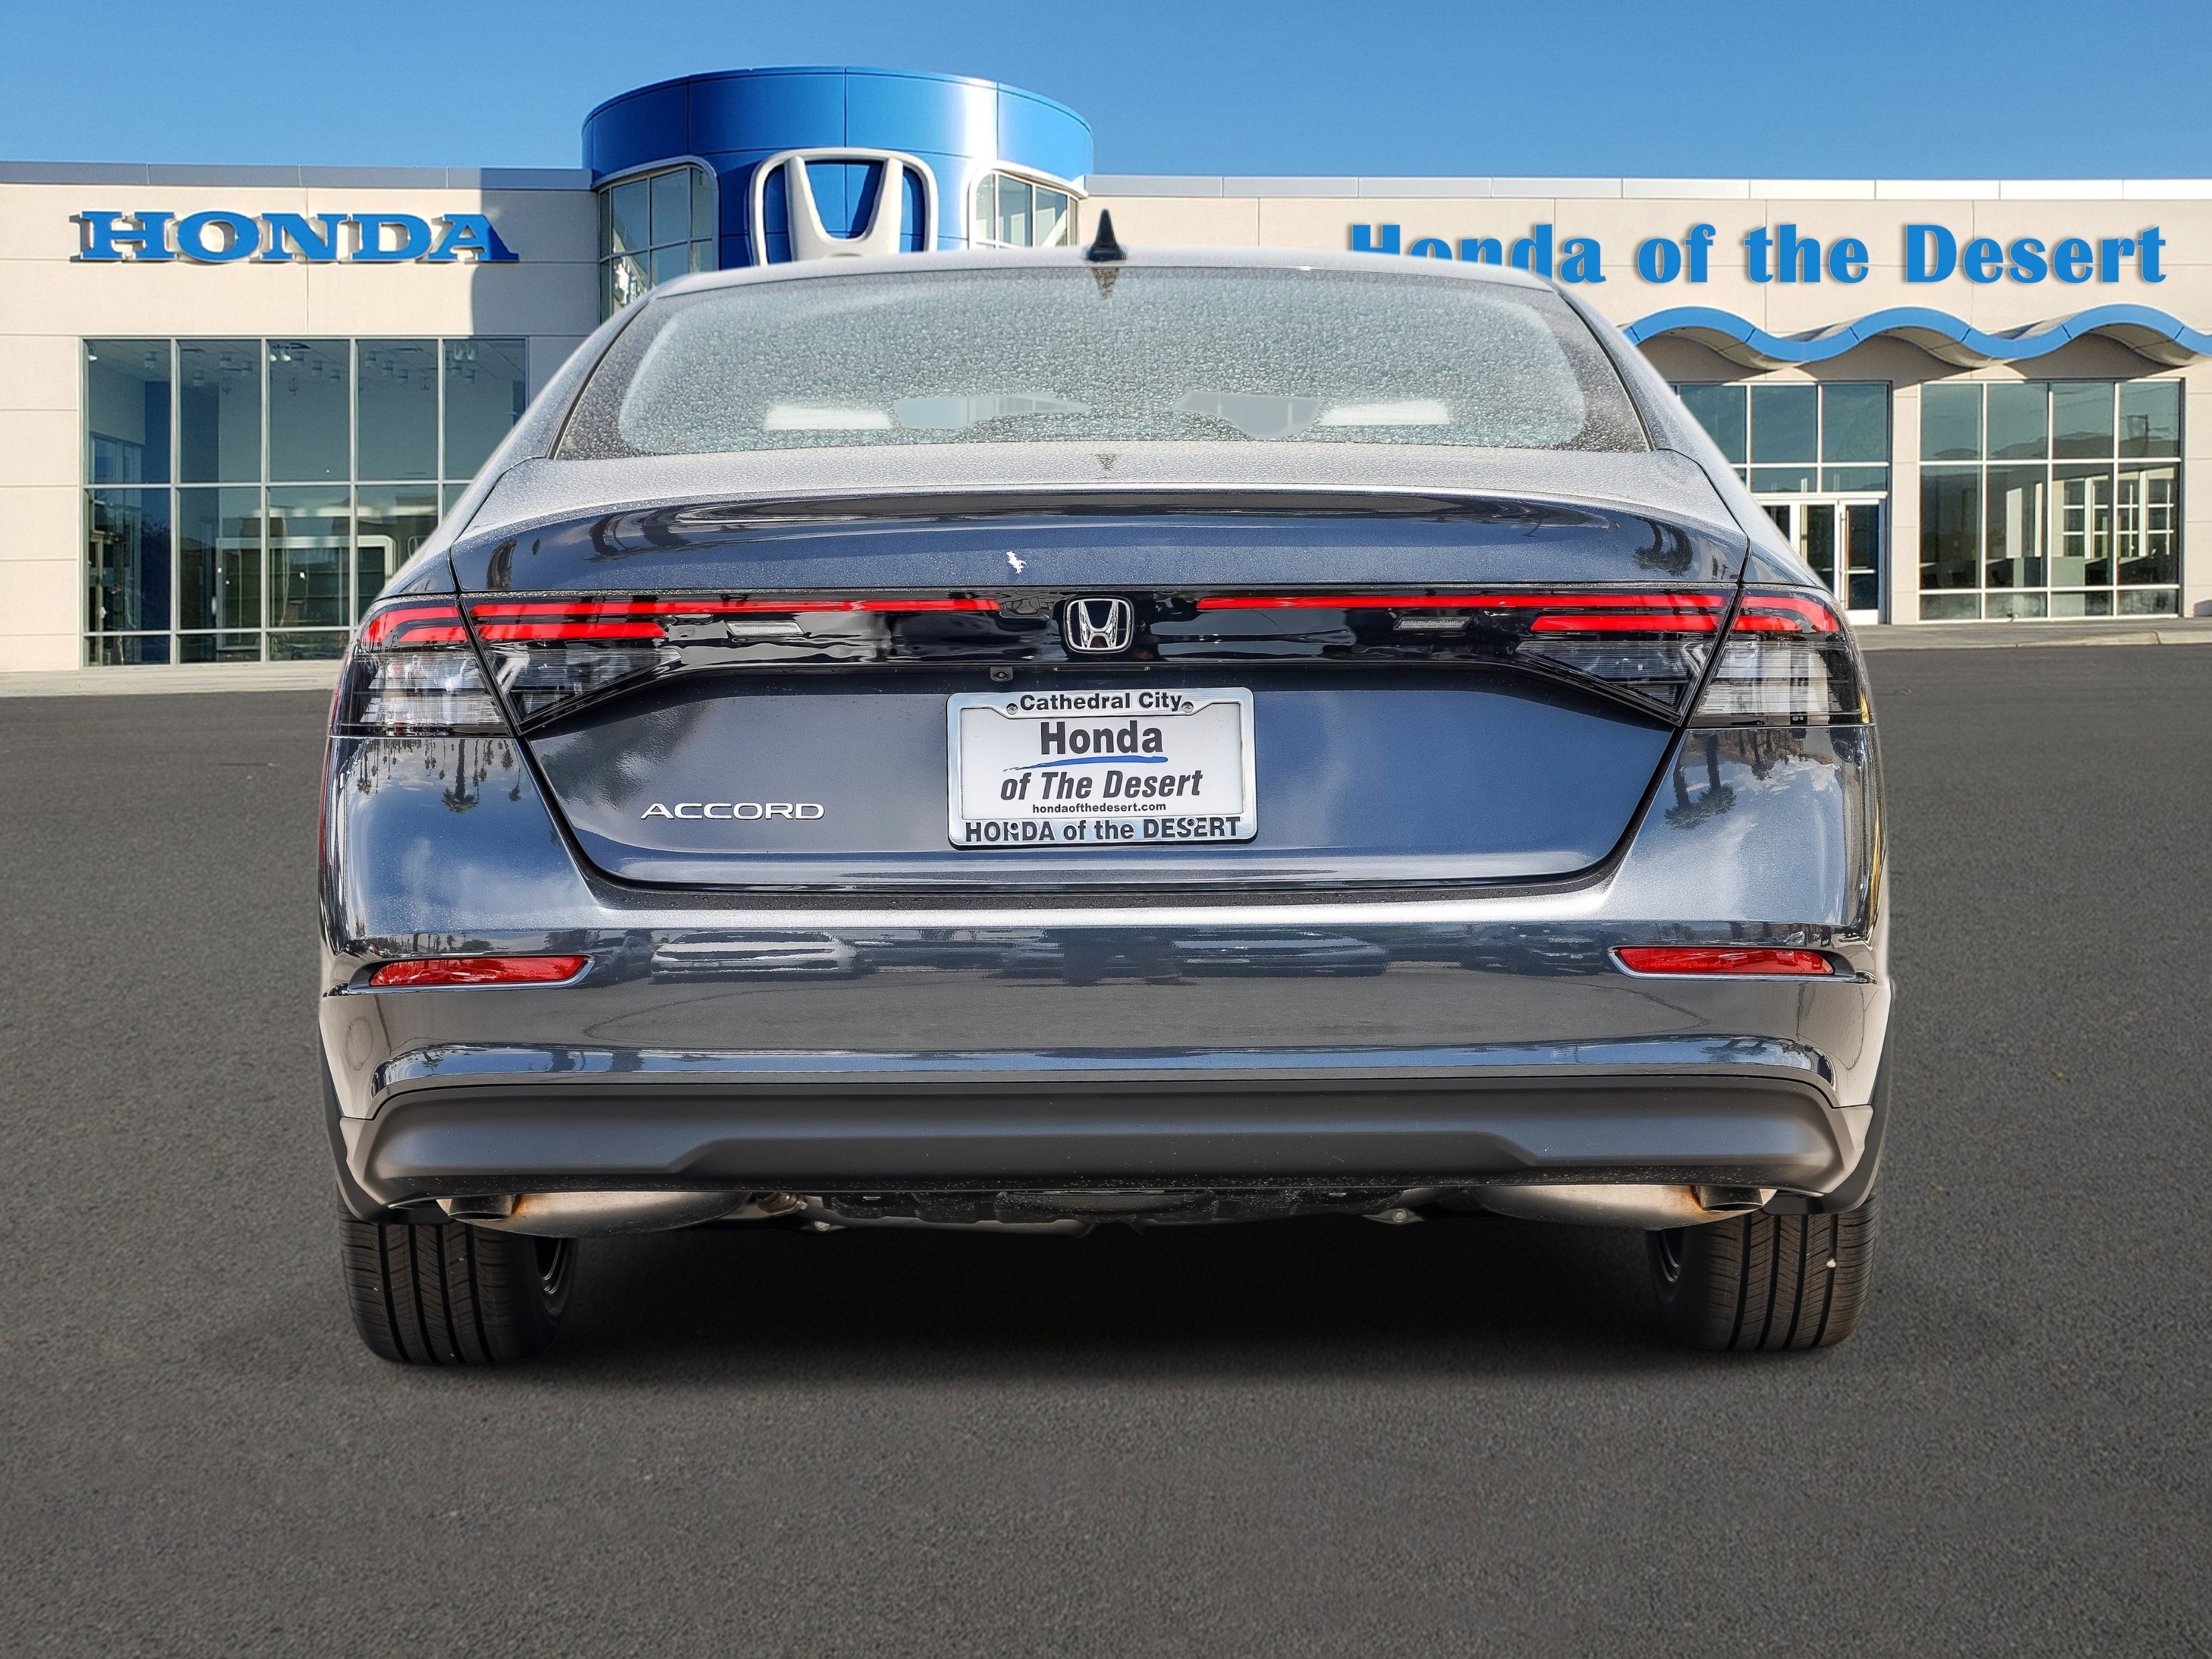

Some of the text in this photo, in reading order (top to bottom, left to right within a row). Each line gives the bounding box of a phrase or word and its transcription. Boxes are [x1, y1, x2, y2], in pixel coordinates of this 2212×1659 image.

[79, 210, 519, 262] HONDA
[1638, 223, 1716, 284] of
[1744, 223, 1869, 284] the
[1906, 224, 2166, 284] Desert
[1020, 692, 1182, 713] Cathedral City
[1041, 721, 1163, 755] Honda
[1000, 770, 1203, 800] of The Desert
[640, 802, 825, 820] ACCORD
[1032, 802, 1166, 814] hondaofthedesert.com
[965, 816, 1241, 842] HONDA of the DESERT
